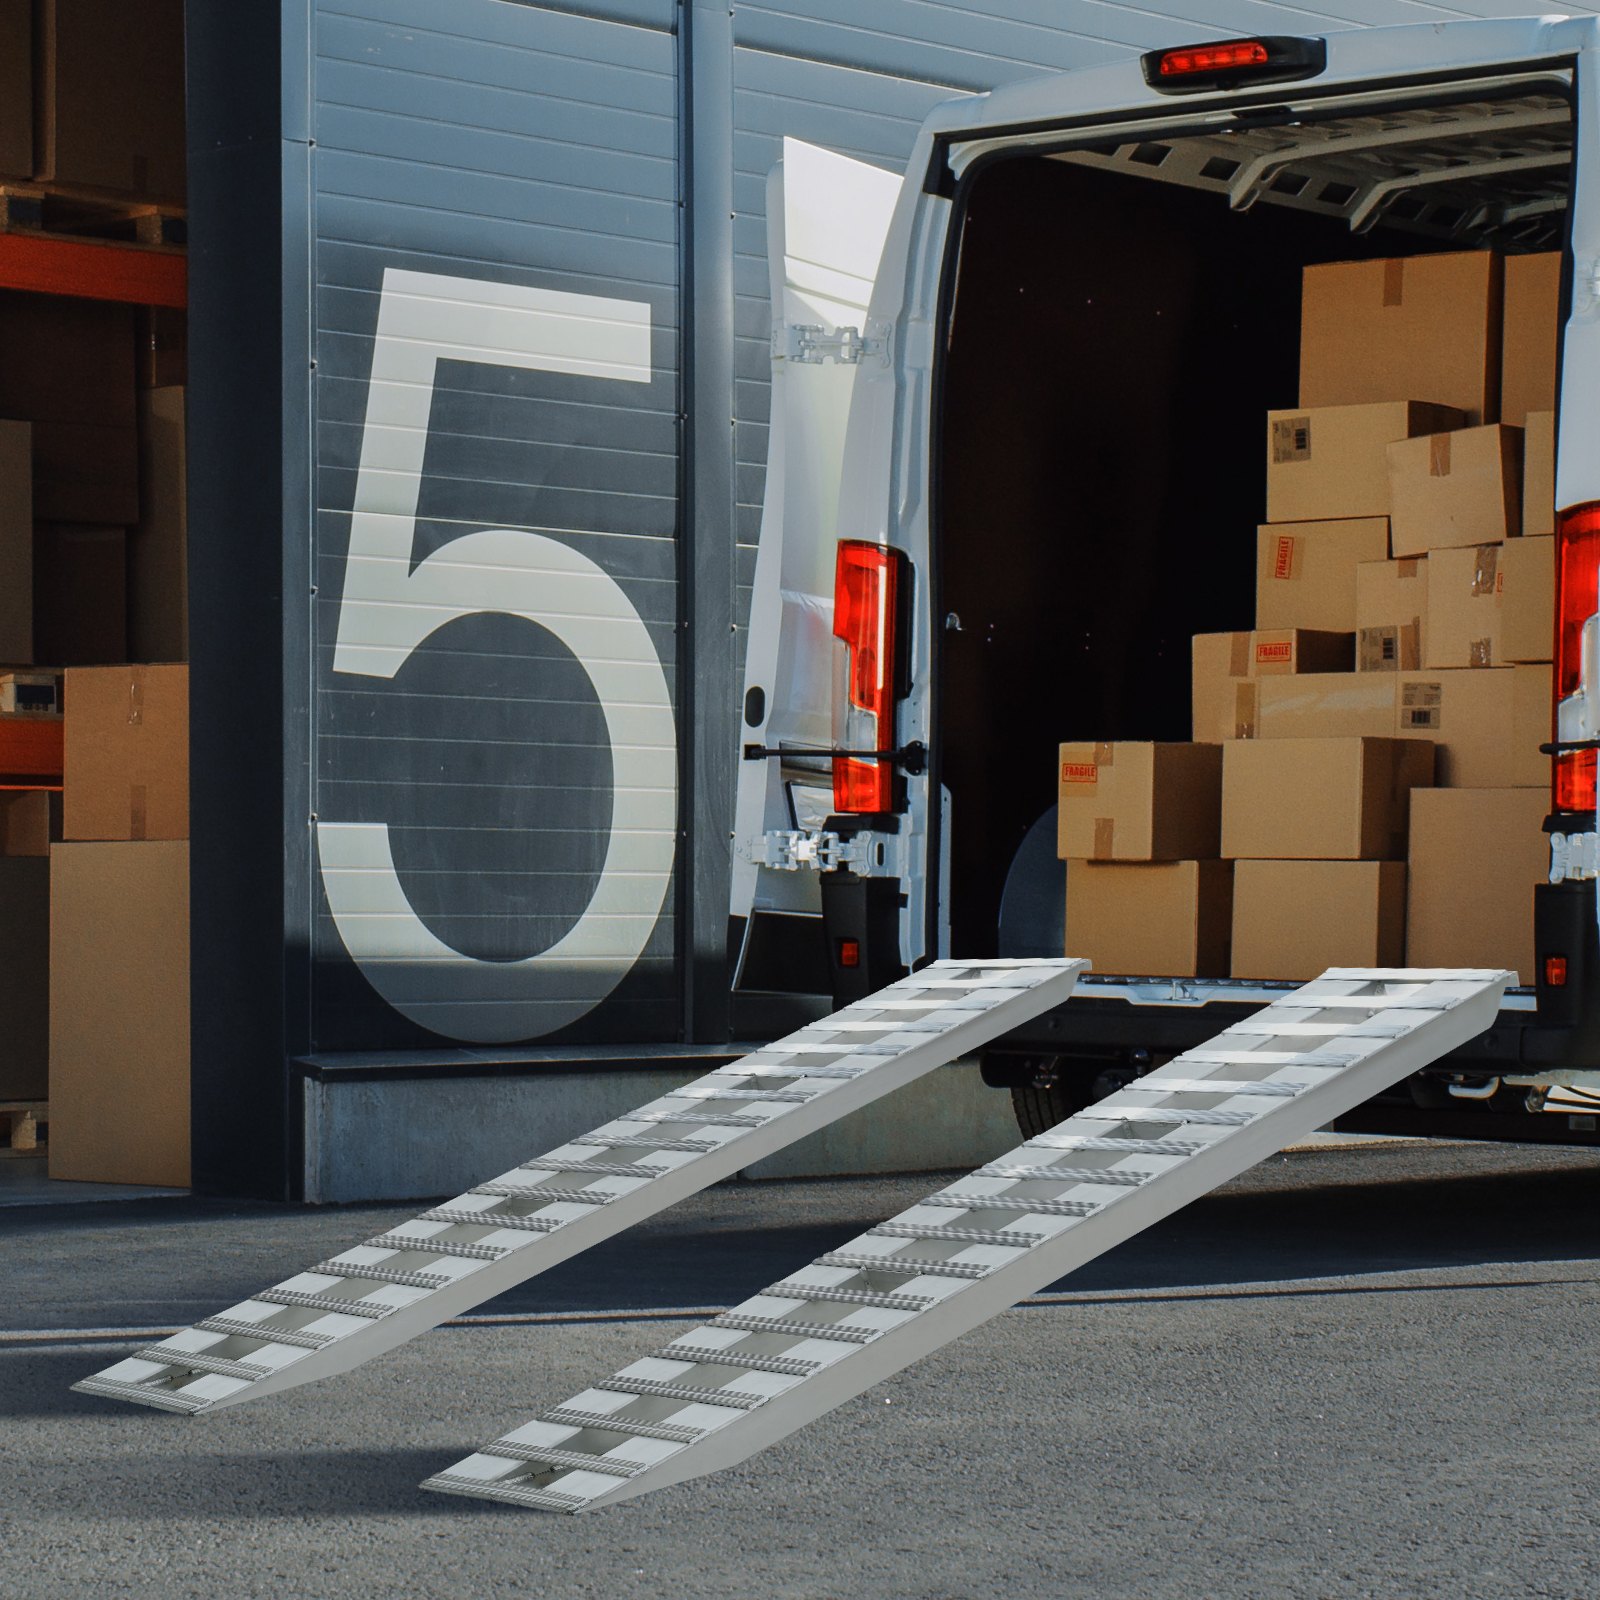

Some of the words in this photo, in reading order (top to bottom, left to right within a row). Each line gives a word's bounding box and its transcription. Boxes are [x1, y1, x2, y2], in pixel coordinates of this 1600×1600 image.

[1277, 540, 1289, 576] FRAGILE
[317, 267, 678, 1043] 5
[1259, 645, 1289, 657] FRAGILE
[1065, 766, 1096, 777] FRAGILE
